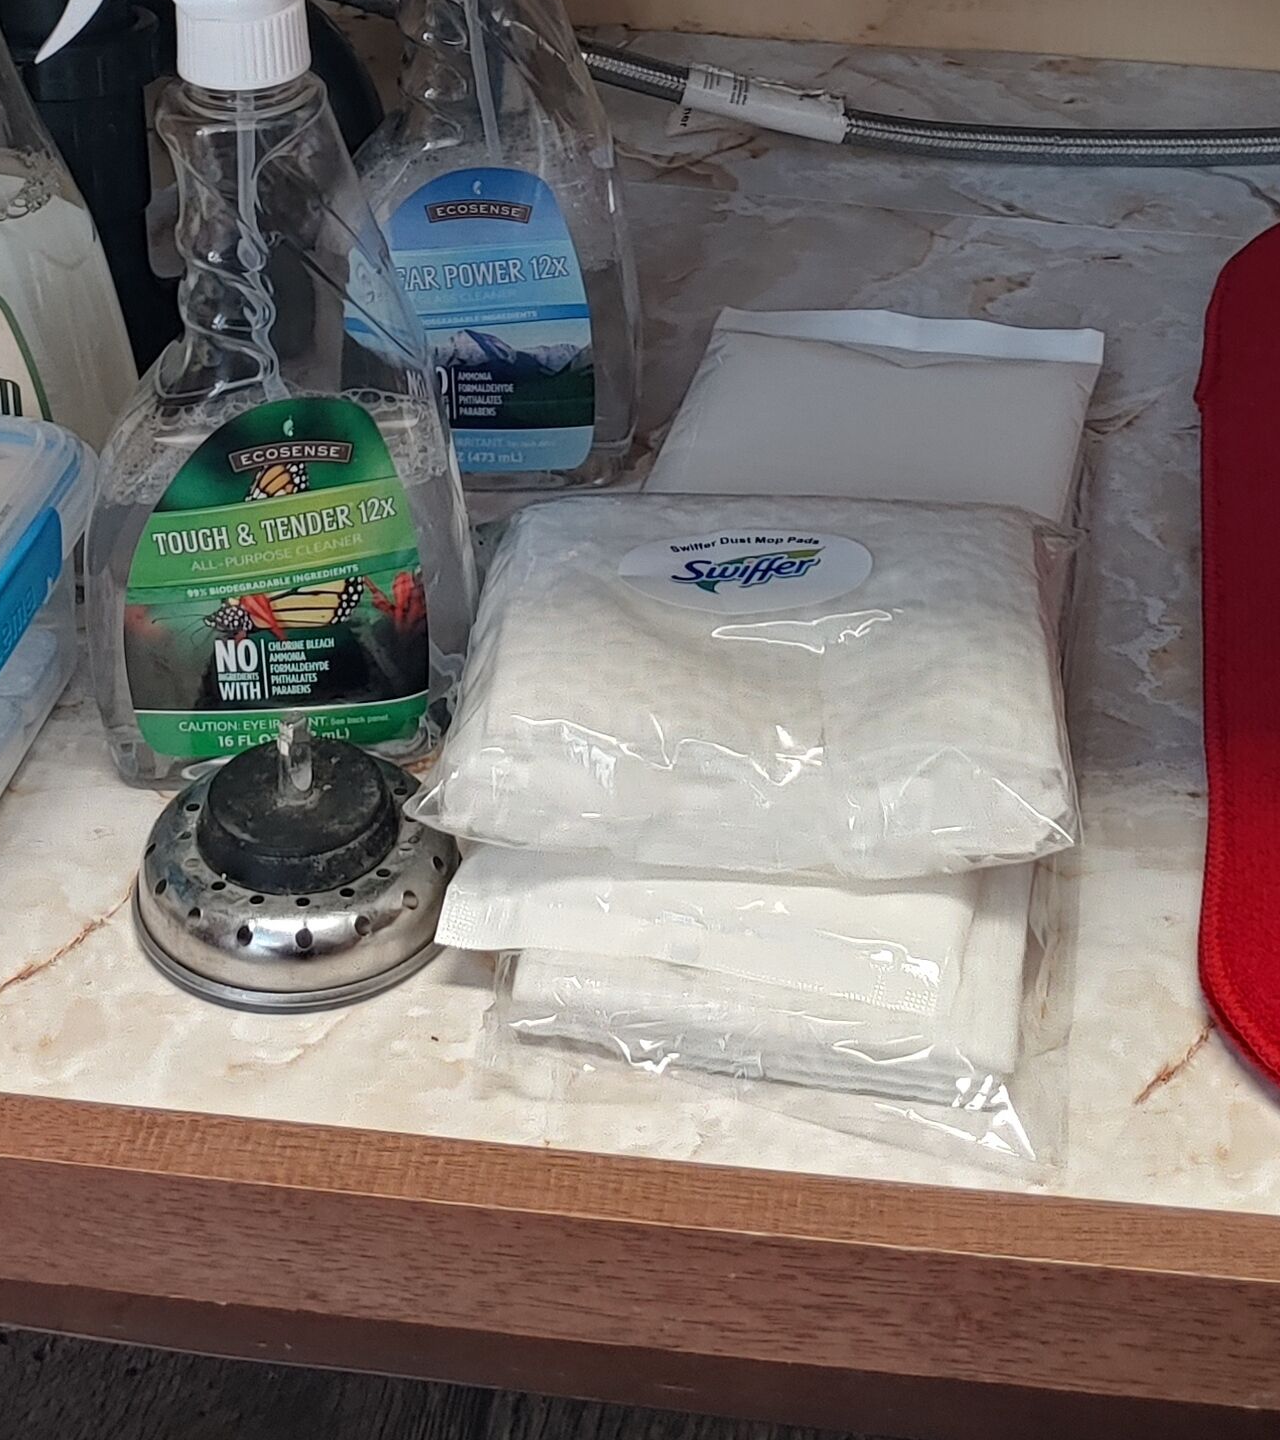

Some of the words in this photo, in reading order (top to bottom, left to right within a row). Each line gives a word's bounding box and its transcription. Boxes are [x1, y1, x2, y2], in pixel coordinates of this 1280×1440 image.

[435, 203, 521, 218] ECOSENSE
[444, 259, 525, 288] POWER
[458, 371, 492, 381] AMMONIA
[458, 383, 514, 393] FORMALDEHYDE
[459, 396, 502, 405] PHTHALATES
[460, 406, 496, 416] PARABENS
[240, 445, 340, 465] ECOSENSE
[152, 525, 230, 556] TOUGH
[236, 523, 256, 547] &
[260, 504, 353, 544] TENDER
[295, 533, 363, 555] CLEANER
[670, 540, 716, 553] Swiffer
[720, 536, 752, 545] Dust
[755, 536, 783, 545] Mop
[787, 536, 820, 545] Pads
[671, 555, 819, 585] Swiffer
[187, 587, 207, 599] 99%
[209, 575, 291, 596] BIODEGRADABLE
[292, 563, 359, 584] INGREDIENTS
[268, 641, 304, 651] CHLORINE
[306, 638, 335, 649] BLEACH
[215, 639, 259, 673] NO
[269, 651, 307, 662] AMMONIA
[270, 661, 330, 673] FORMALDEHYDE
[218, 671, 260, 681] INGREDIENTS
[271, 672, 318, 683] PHTHALATES
[219, 681, 261, 701] WITH
[272, 684, 312, 695] PARABENS
[179, 720, 241, 733] CAUTION:
[243, 719, 267, 730] EYE
[218, 736, 234, 747] 16
[238, 734, 256, 747] FL
[322, 728, 350, 740] mL)
